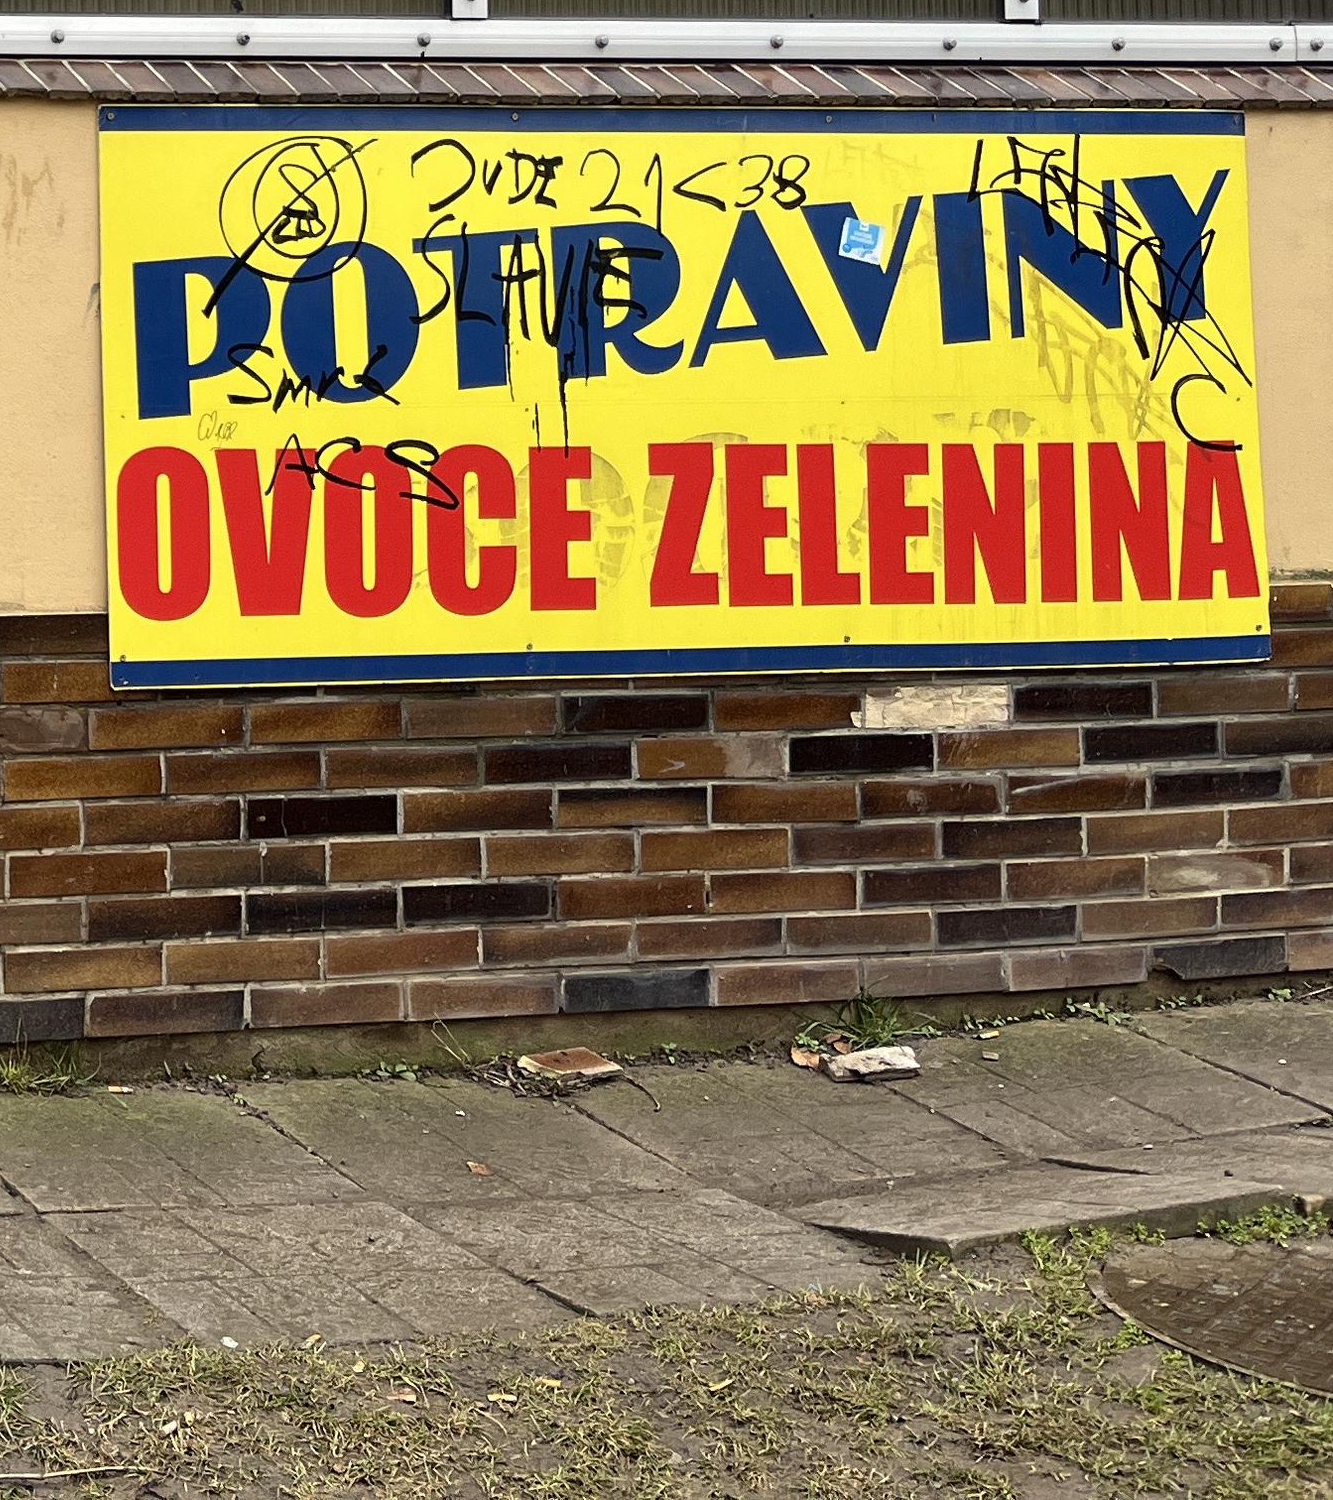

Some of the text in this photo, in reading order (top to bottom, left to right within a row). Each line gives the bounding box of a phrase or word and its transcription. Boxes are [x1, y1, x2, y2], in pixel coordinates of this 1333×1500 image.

[133, 169, 1230, 419] POTRAVINY
[116, 441, 1260, 621] OVOCE ZELENINA
